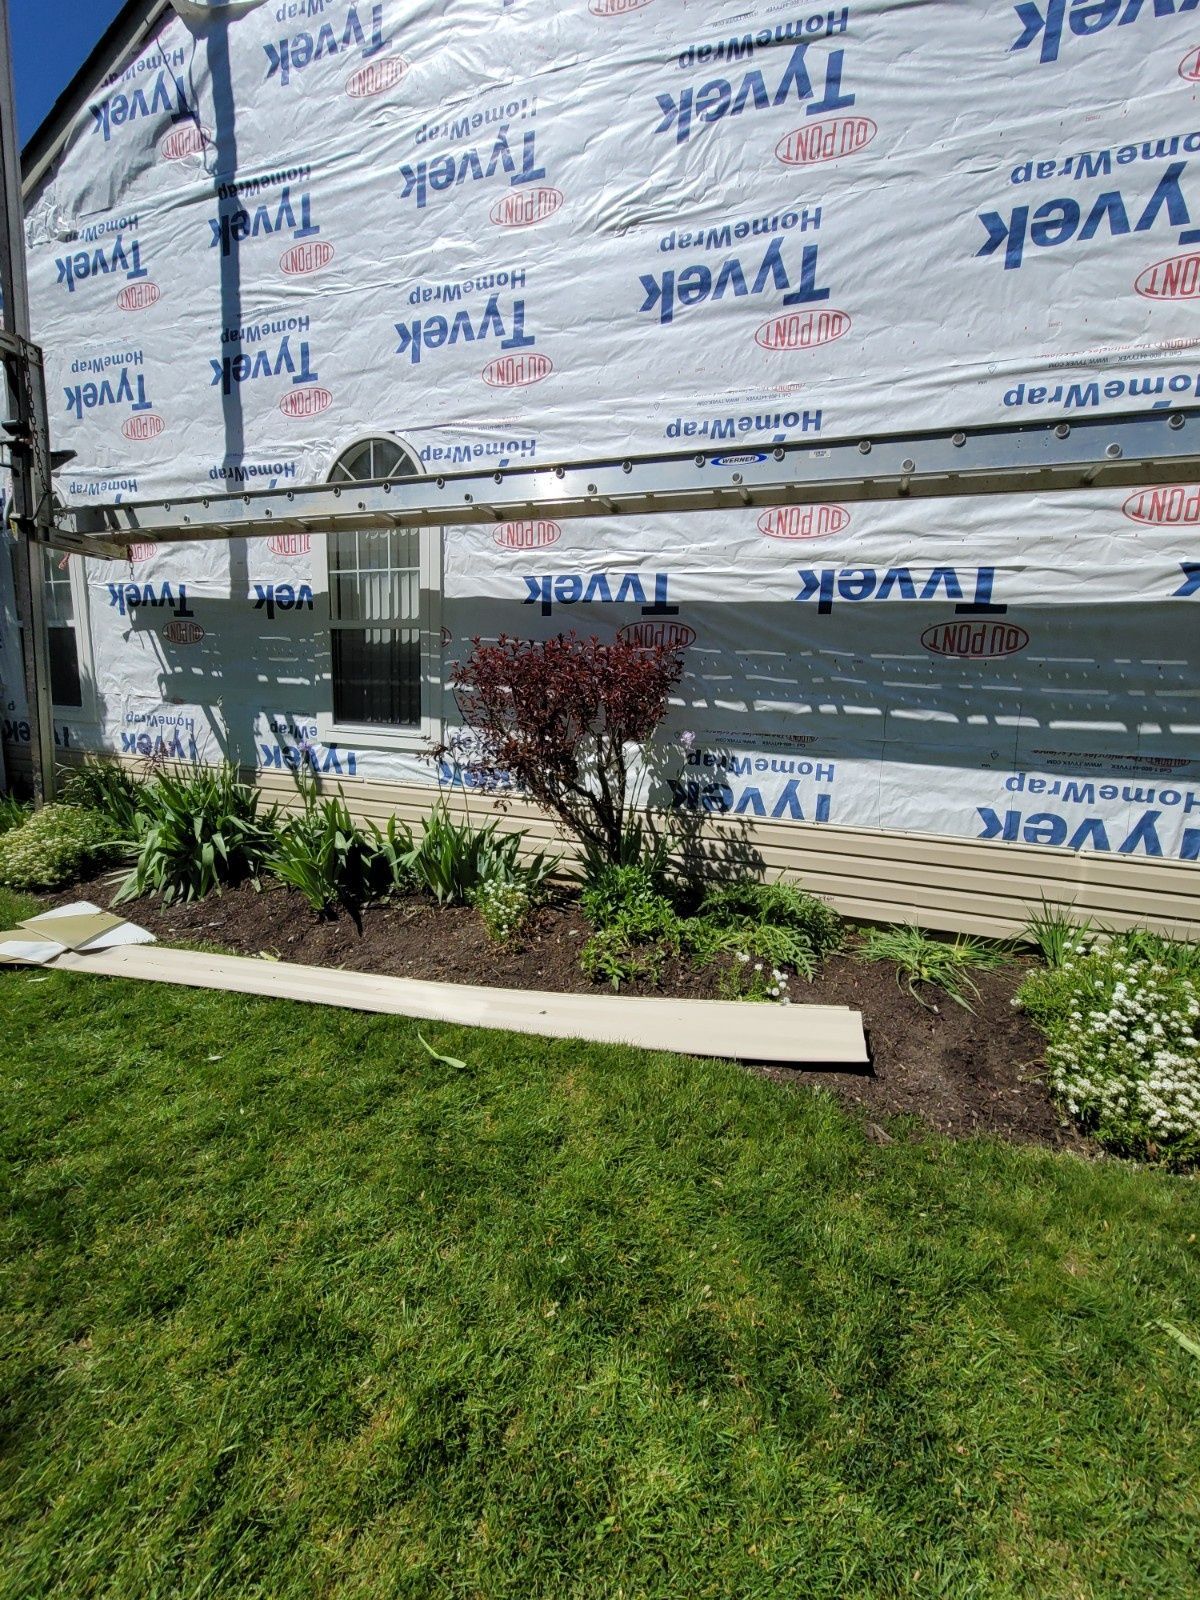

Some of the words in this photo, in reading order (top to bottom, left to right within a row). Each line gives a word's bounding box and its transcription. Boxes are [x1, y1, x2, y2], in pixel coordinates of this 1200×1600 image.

[263, 4, 392, 86] Tyvek
[678, 7, 849, 68] HomeWrap
[89, 70, 199, 141] Tyvek
[655, 42, 855, 145] Tyvek
[415, 95, 537, 145] HomeWrap
[400, 124, 545, 208] Tyvek
[1011, 131, 1200, 185] omeWrap
[218, 166, 311, 200] HomeWrap
[208, 186, 320, 256] Tyvek
[660, 206, 821, 252] HomeWrap
[975, 160, 1200, 269] yvek
[55, 234, 148, 292] Tyvek
[639, 237, 830, 324] Tyvek
[409, 268, 526, 306] HomeWrap
[221, 315, 310, 344] HomeWrap
[394, 293, 536, 363] Tyvek
[71, 350, 143, 374] HomeWrap
[209, 335, 318, 395] Tyvek
[64, 368, 152, 419] Tyvek
[666, 410, 823, 438] HomeWrap
[209, 462, 295, 481] HomeWrap
[421, 439, 536, 463] HomeWrap
[722, 456, 756, 464] WERNER
[69, 479, 138, 495] HomeWrap
[107, 581, 194, 617] Tyvek
[253, 584, 313, 619] vek
[127, 713, 194, 731] HomeWrap
[270, 721, 317, 739] eWrap
[687, 750, 835, 782] HomeWrap
